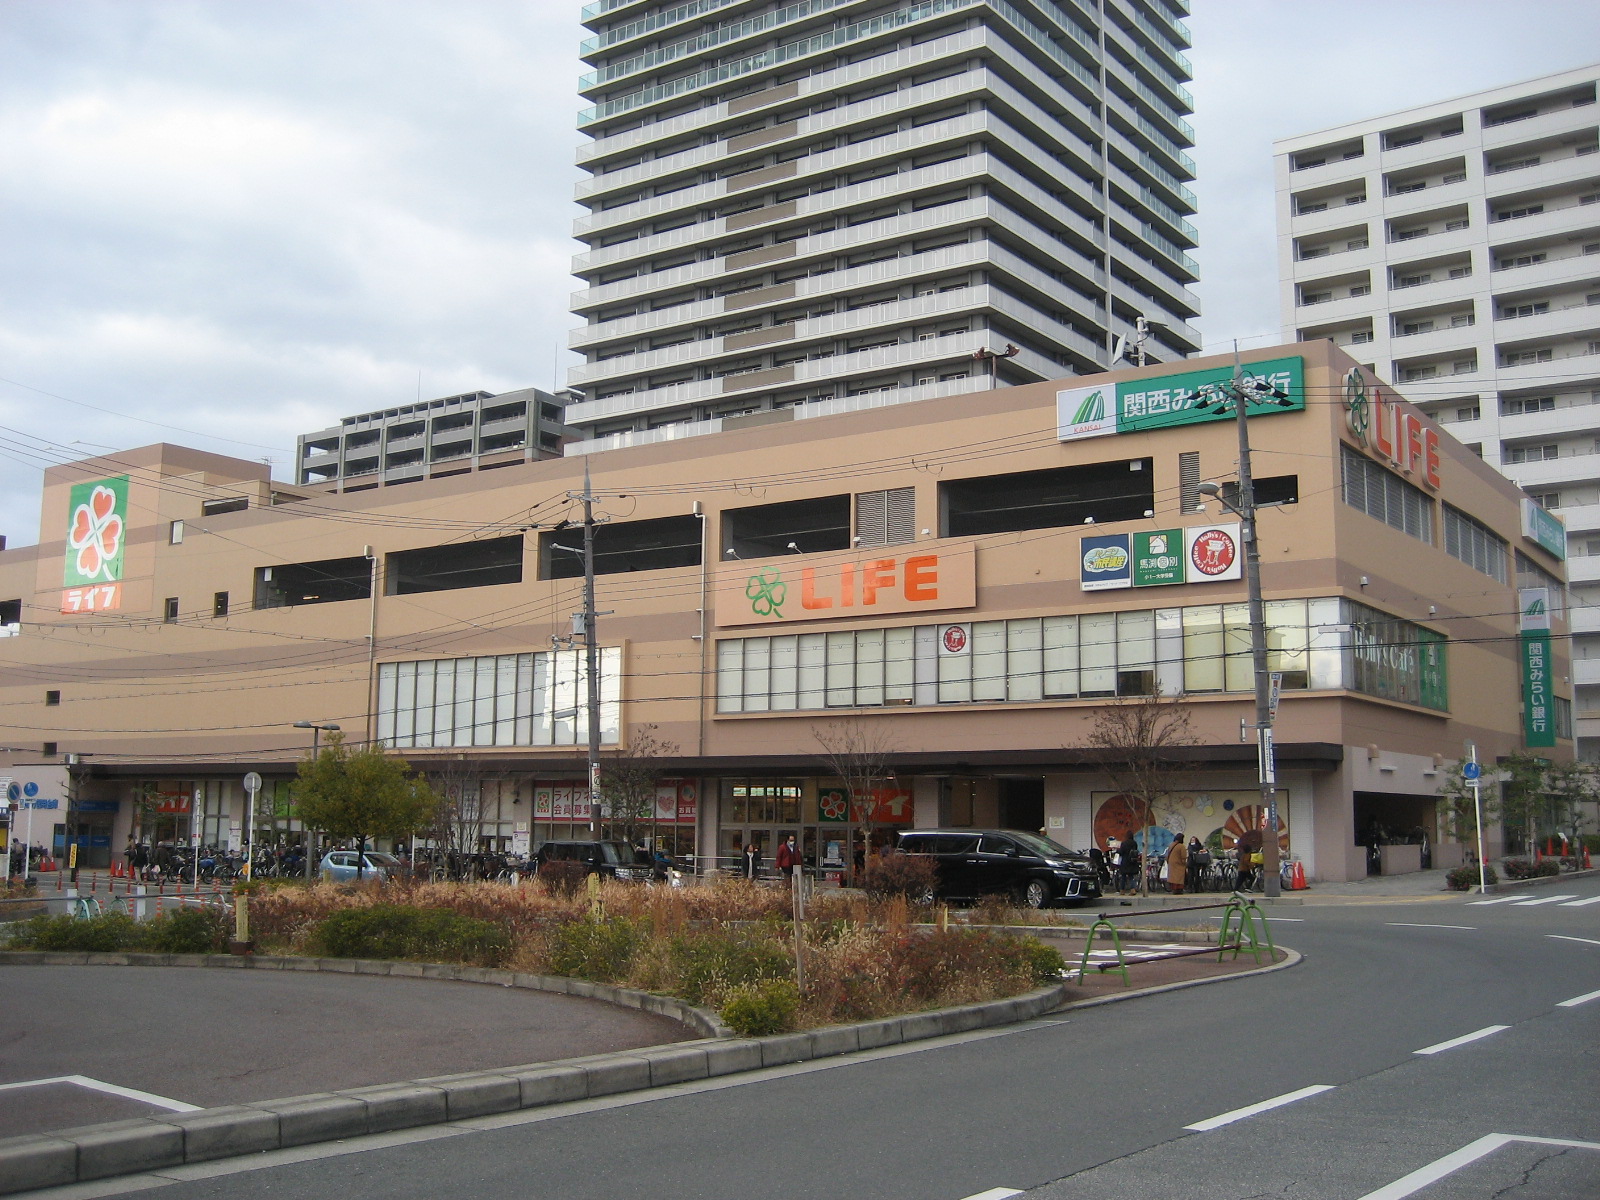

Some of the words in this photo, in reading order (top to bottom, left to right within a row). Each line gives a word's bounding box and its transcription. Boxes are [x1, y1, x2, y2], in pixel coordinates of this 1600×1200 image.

[1369, 387, 1440, 490] LIFE
[68, 585, 116, 611] ライフ
[801, 554, 938, 610] LIFE
[1354, 629, 1387, 670] Holly's
[1528, 642, 1546, 733] 関西みらい銀行
[553, 804, 592, 816] 会員募集
